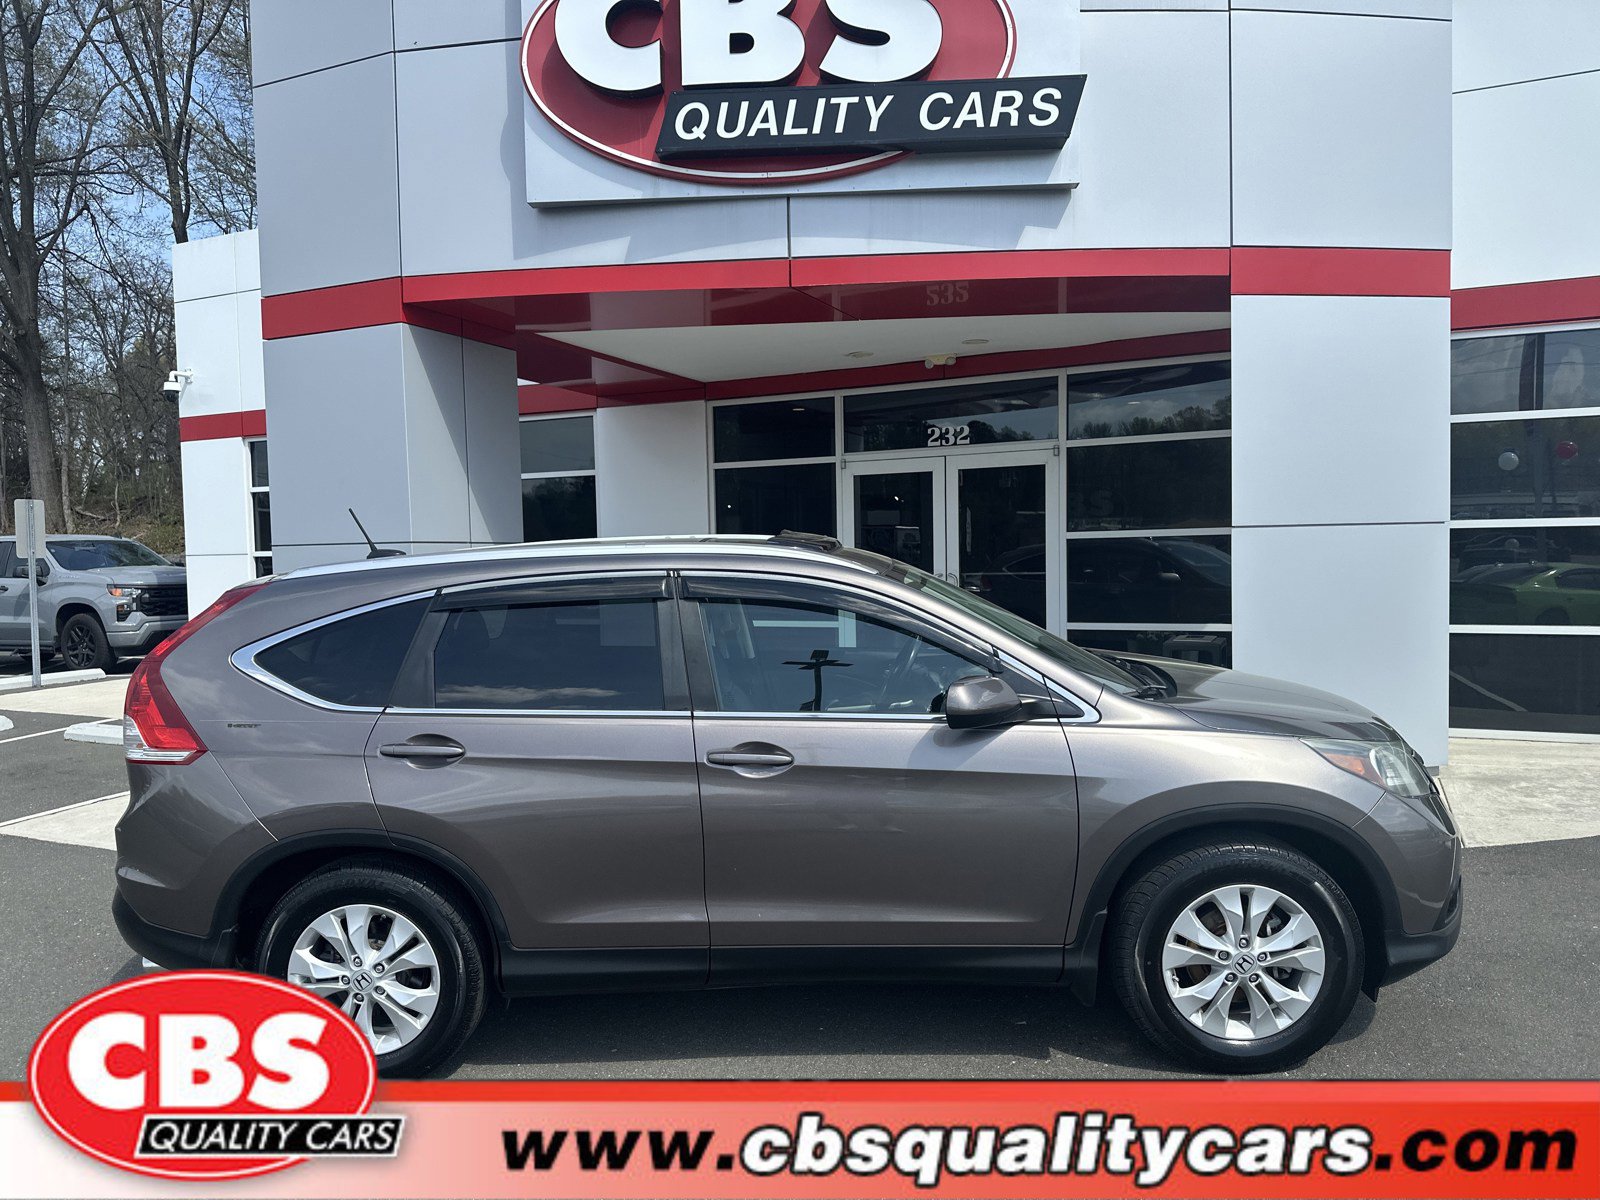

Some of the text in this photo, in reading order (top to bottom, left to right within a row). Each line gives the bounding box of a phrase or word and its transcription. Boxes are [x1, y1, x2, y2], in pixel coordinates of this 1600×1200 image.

[554, 0, 943, 92] CBS
[673, 87, 1063, 141] QUALITY CARS
[927, 424, 970, 447] 232
